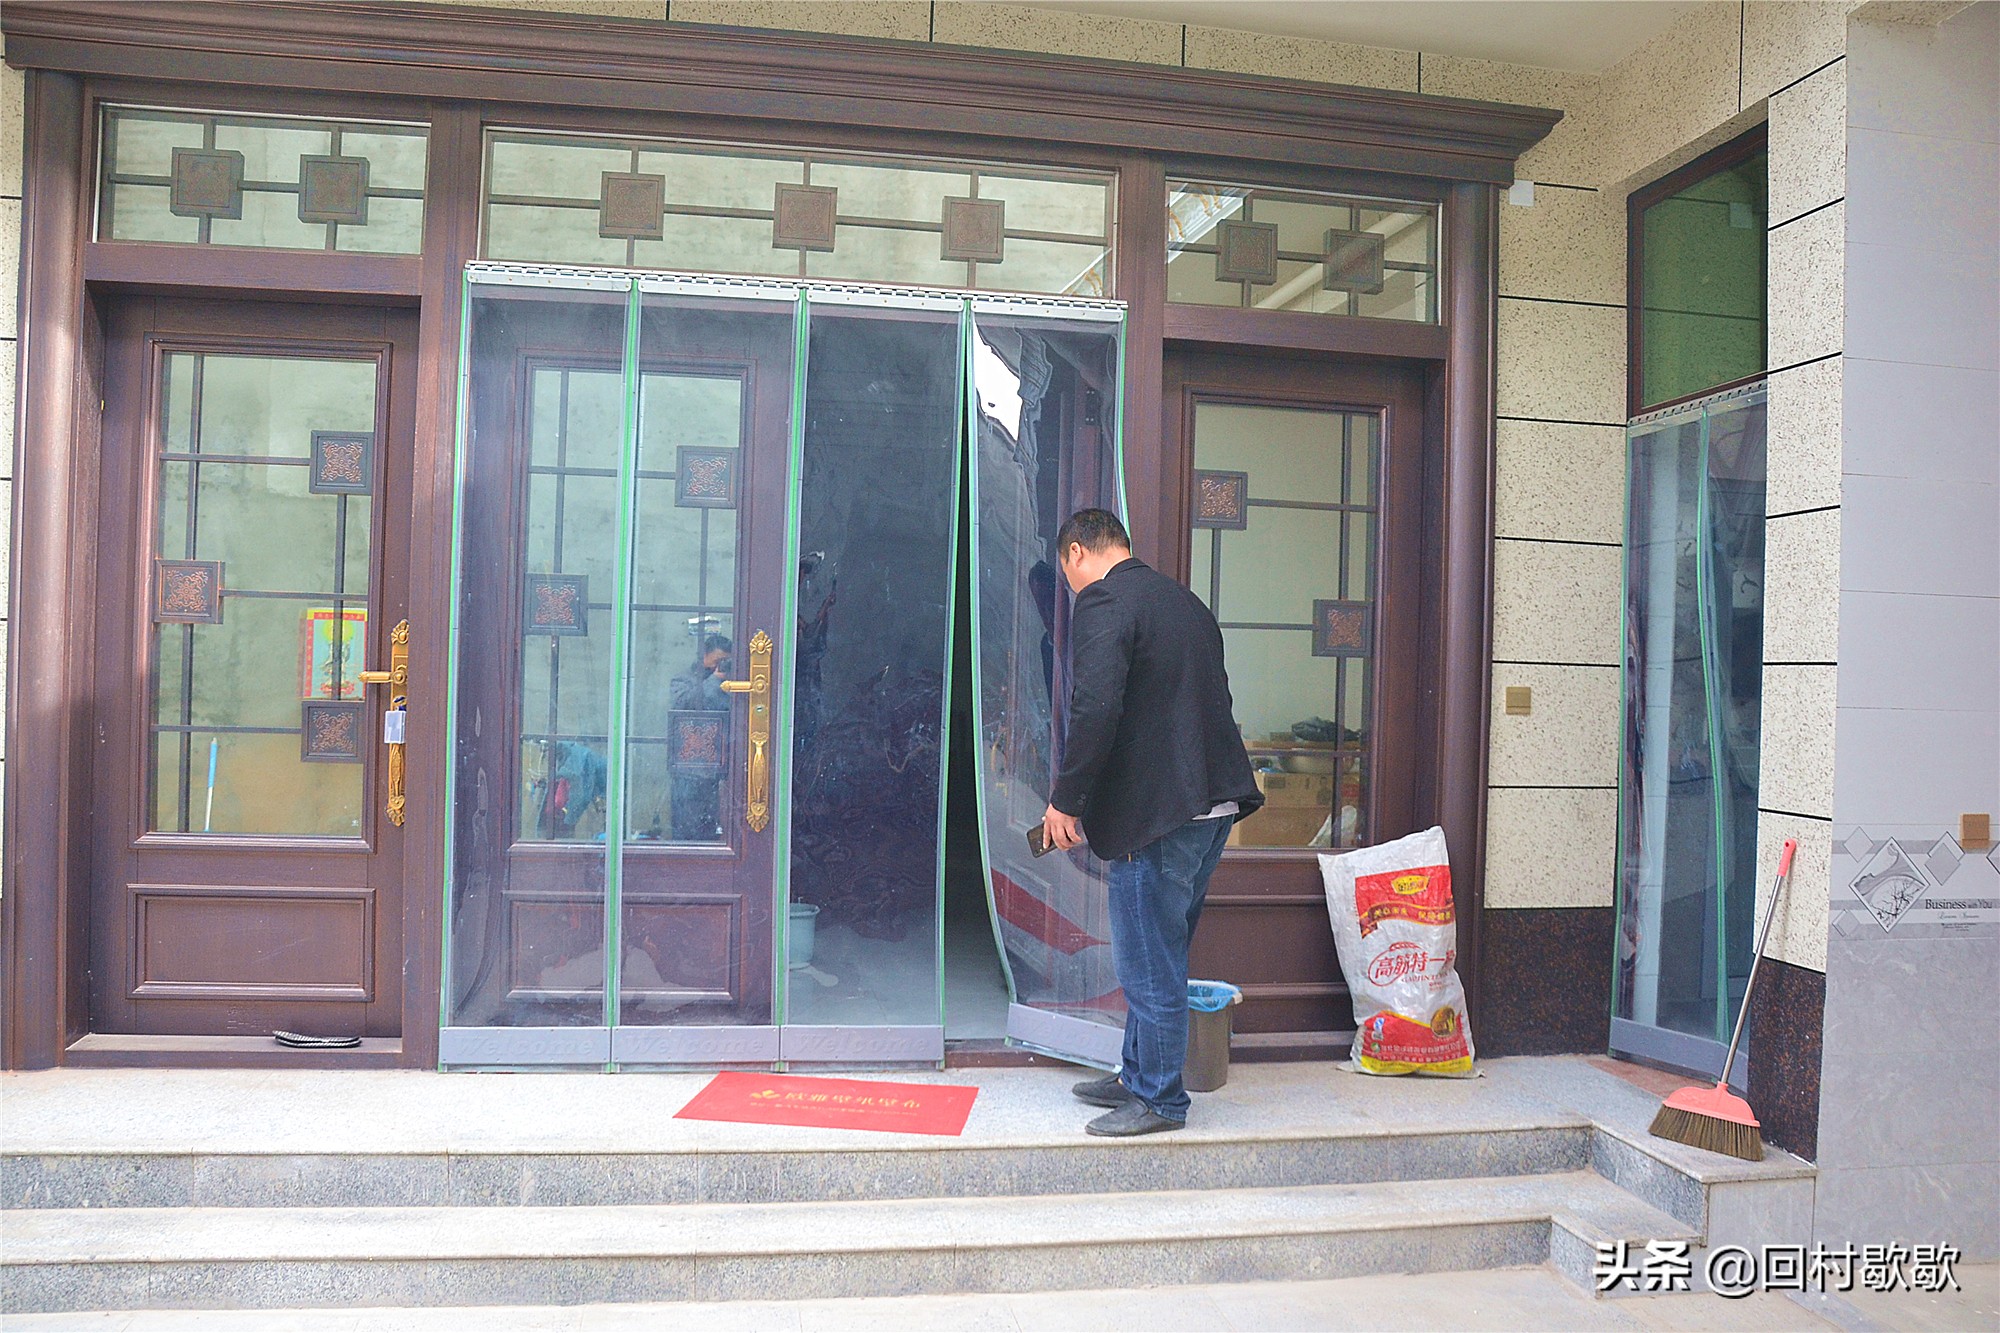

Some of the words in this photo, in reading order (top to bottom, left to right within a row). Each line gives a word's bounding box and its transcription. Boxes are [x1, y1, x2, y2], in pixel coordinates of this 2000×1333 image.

[1925, 898, 1967, 909] Business
[1977, 899, 1993, 909] You
[454, 1034, 594, 1056] Welcome
[625, 1032, 765, 1055] Welcome
[795, 1031, 929, 1054] Welcome
